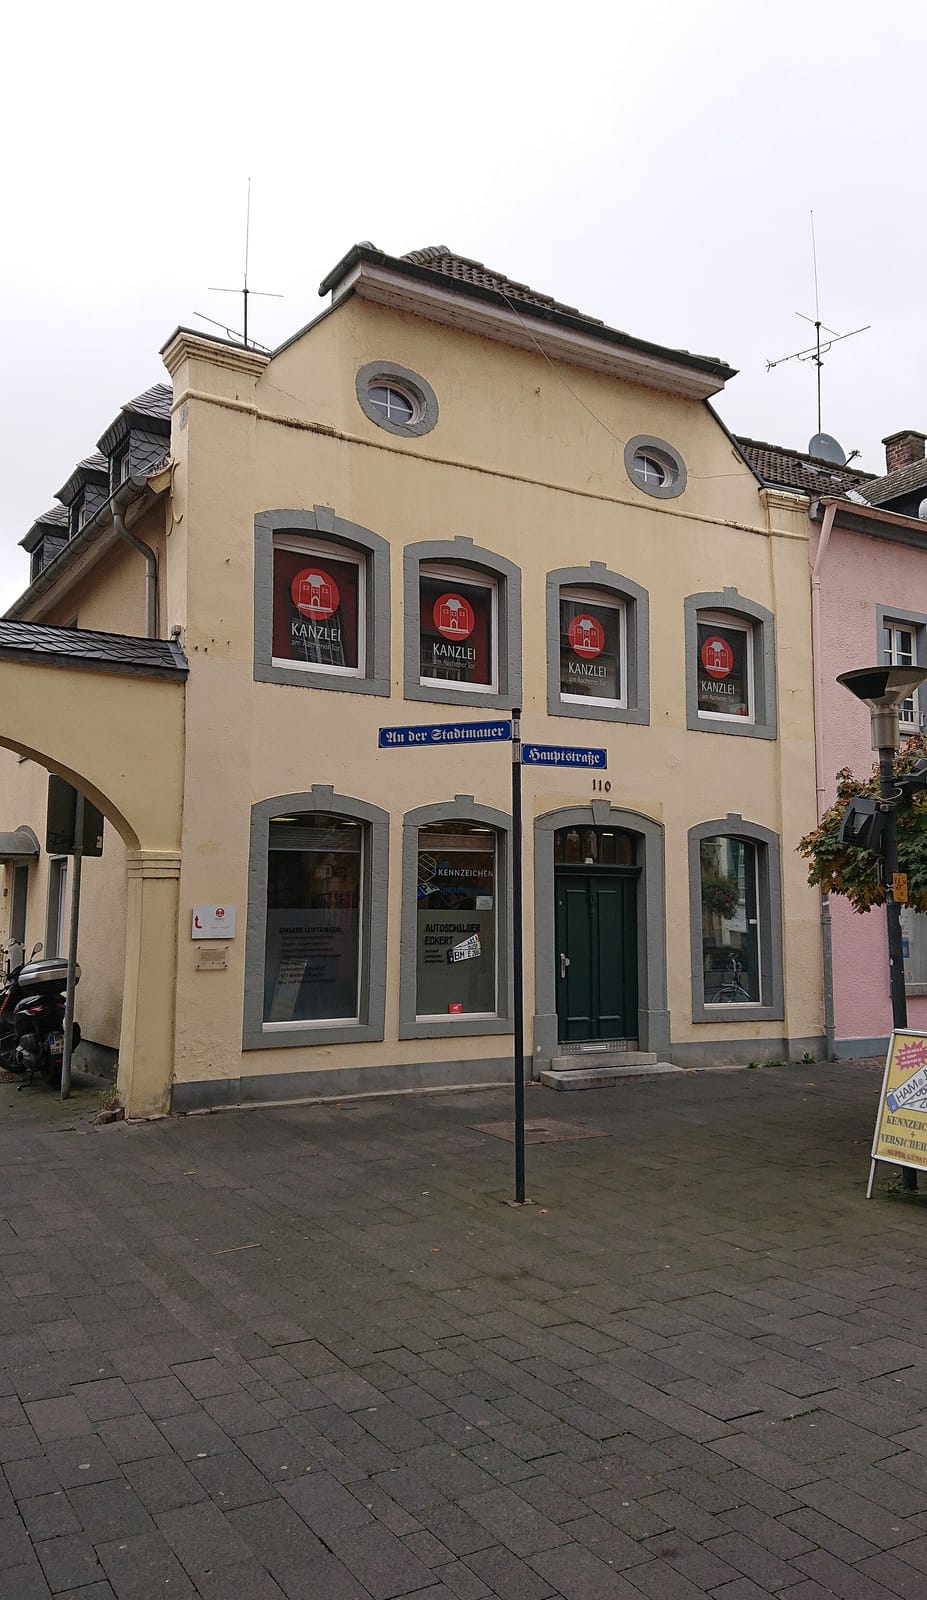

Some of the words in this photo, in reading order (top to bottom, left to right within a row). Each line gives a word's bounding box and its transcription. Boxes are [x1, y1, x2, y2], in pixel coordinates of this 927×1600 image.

[291, 623, 341, 642] KANZLEI
[433, 643, 476, 661] KANZLEI
[568, 661, 607, 678] KANZLEI
[701, 680, 735, 695] KANZLEI
[385, 731, 405, 743] An
[408, 730, 427, 742] der
[431, 726, 504, 740] Stadtmauer
[528, 748, 600, 766] Hauptstraße
[592, 779, 611, 792] 110
[438, 868, 494, 877] KENNZEICHEN
[425, 923, 480, 933] AUTOSCHILDER
[425, 936, 454, 945] ECKERT
[896, 1079, 918, 1104] HAM
